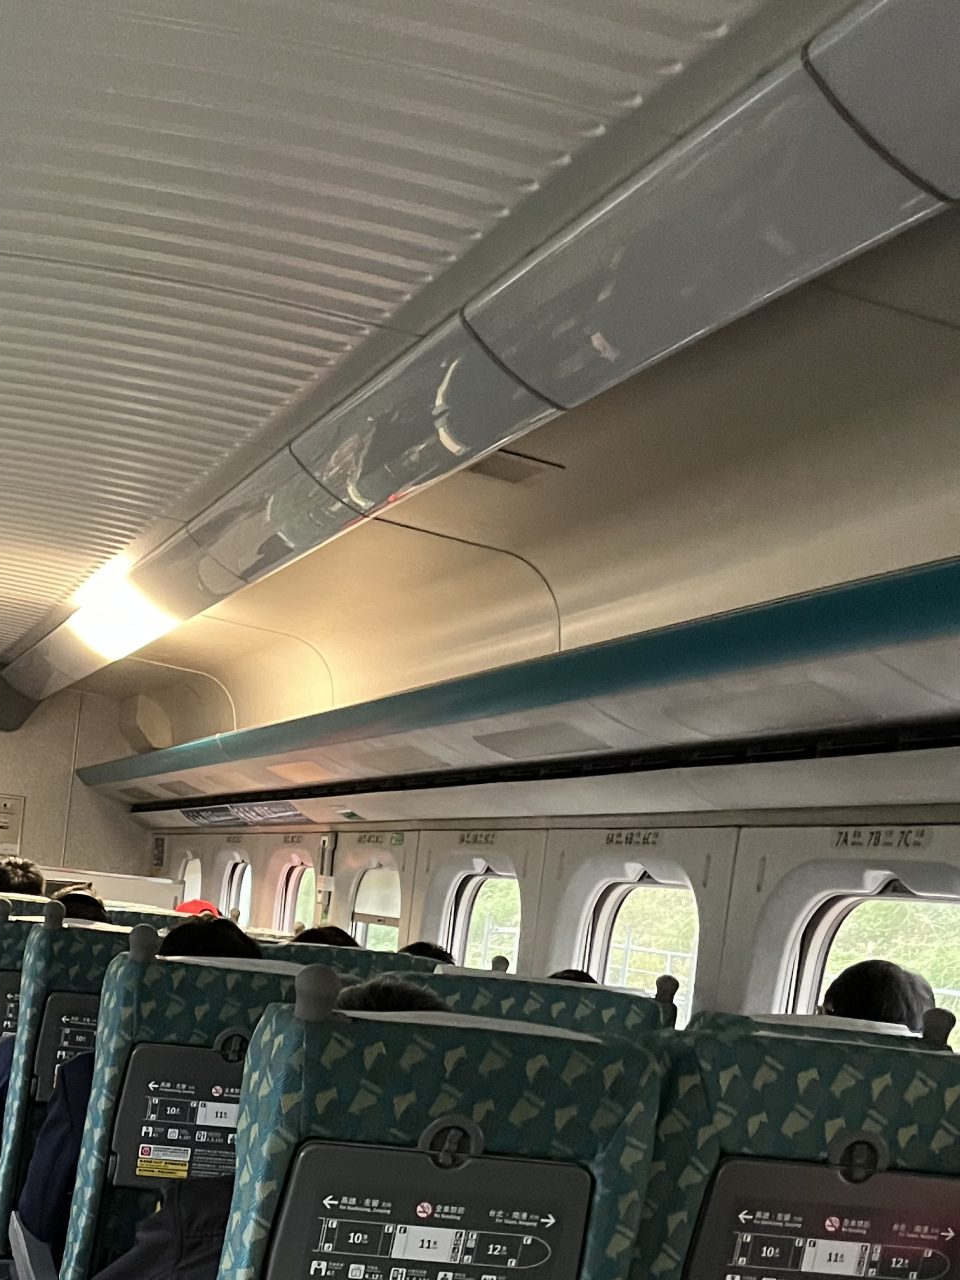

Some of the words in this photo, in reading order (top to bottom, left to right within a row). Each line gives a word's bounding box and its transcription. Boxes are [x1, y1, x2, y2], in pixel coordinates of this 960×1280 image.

[836, 831, 849, 847] 7A
[866, 831, 881, 847] 7B
[897, 830, 912, 847] 7C
[166, 1106, 176, 1115] 10
[215, 1111, 223, 1119] 11
[348, 1232, 363, 1244] 10
[418, 1239, 431, 1249] 11
[487, 1244, 501, 1255] 12
[760, 1246, 774, 1258] 10
[826, 1252, 838, 1262] 11
[890, 1257, 902, 1268] 12
